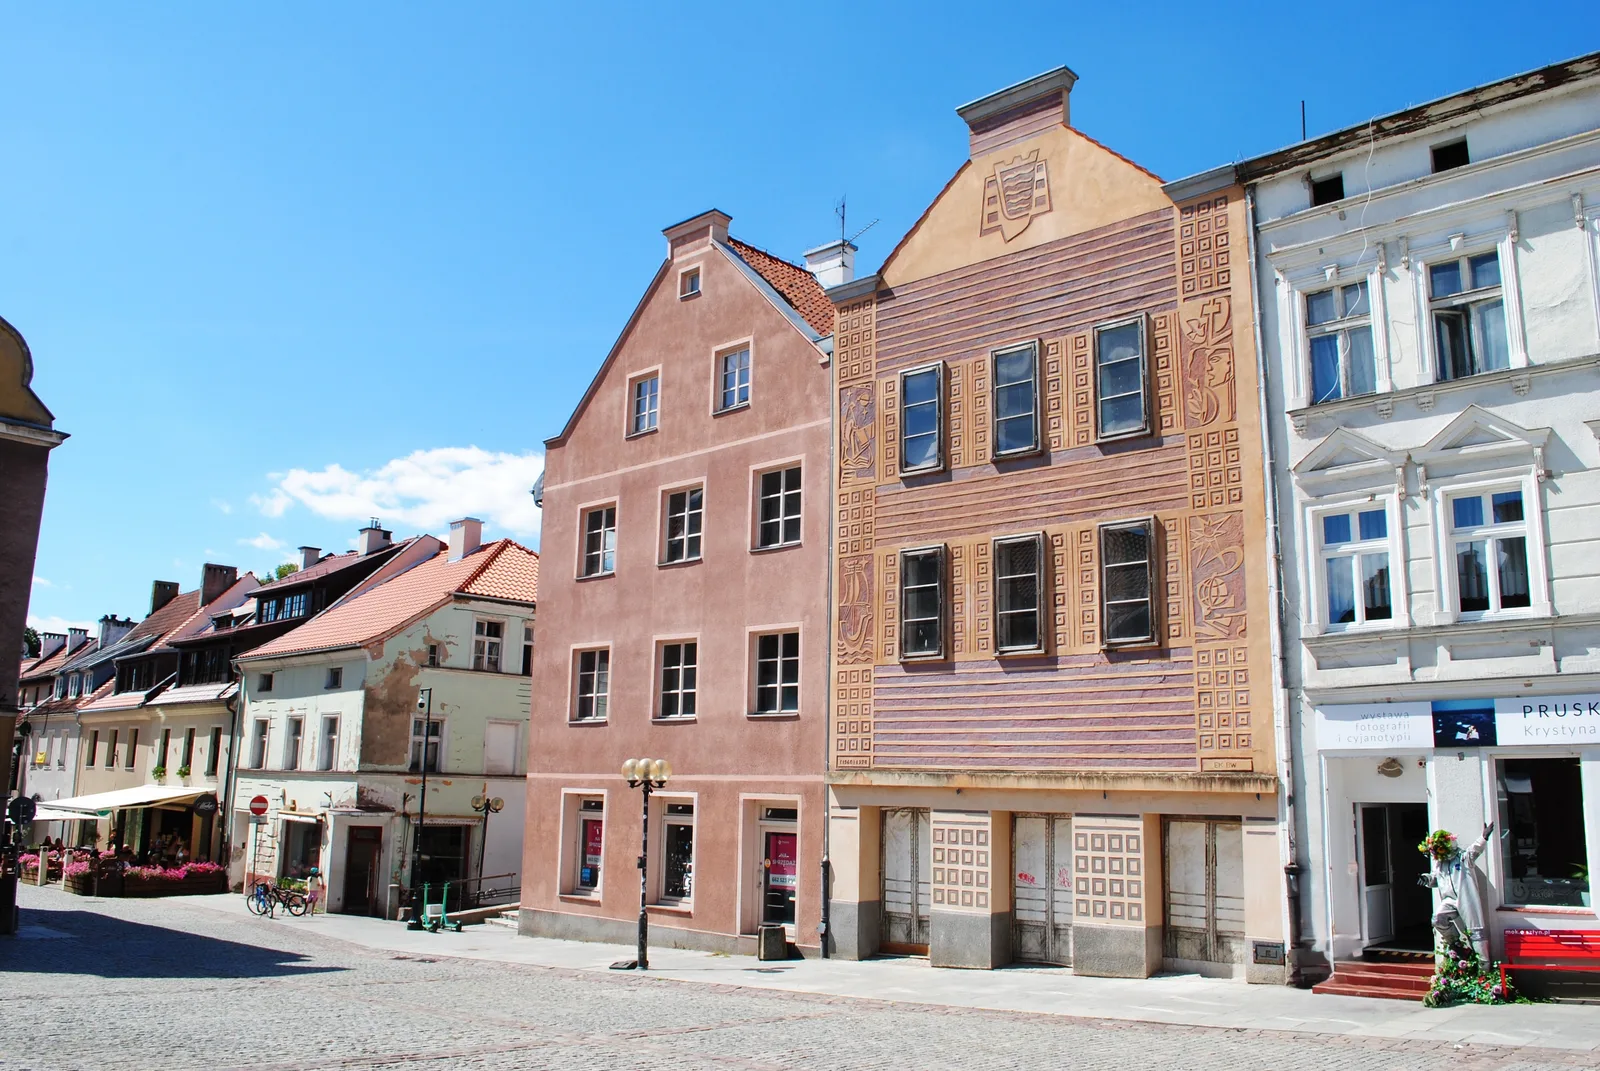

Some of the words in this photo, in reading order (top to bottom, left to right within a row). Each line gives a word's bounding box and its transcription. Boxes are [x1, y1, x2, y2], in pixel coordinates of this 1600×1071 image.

[1360, 711, 1410, 721] wystawa
[1355, 721, 1410, 733] fotografii
[1524, 724, 1597, 738] Krystyna
[1346, 732, 1411, 744] cyjanotypii
